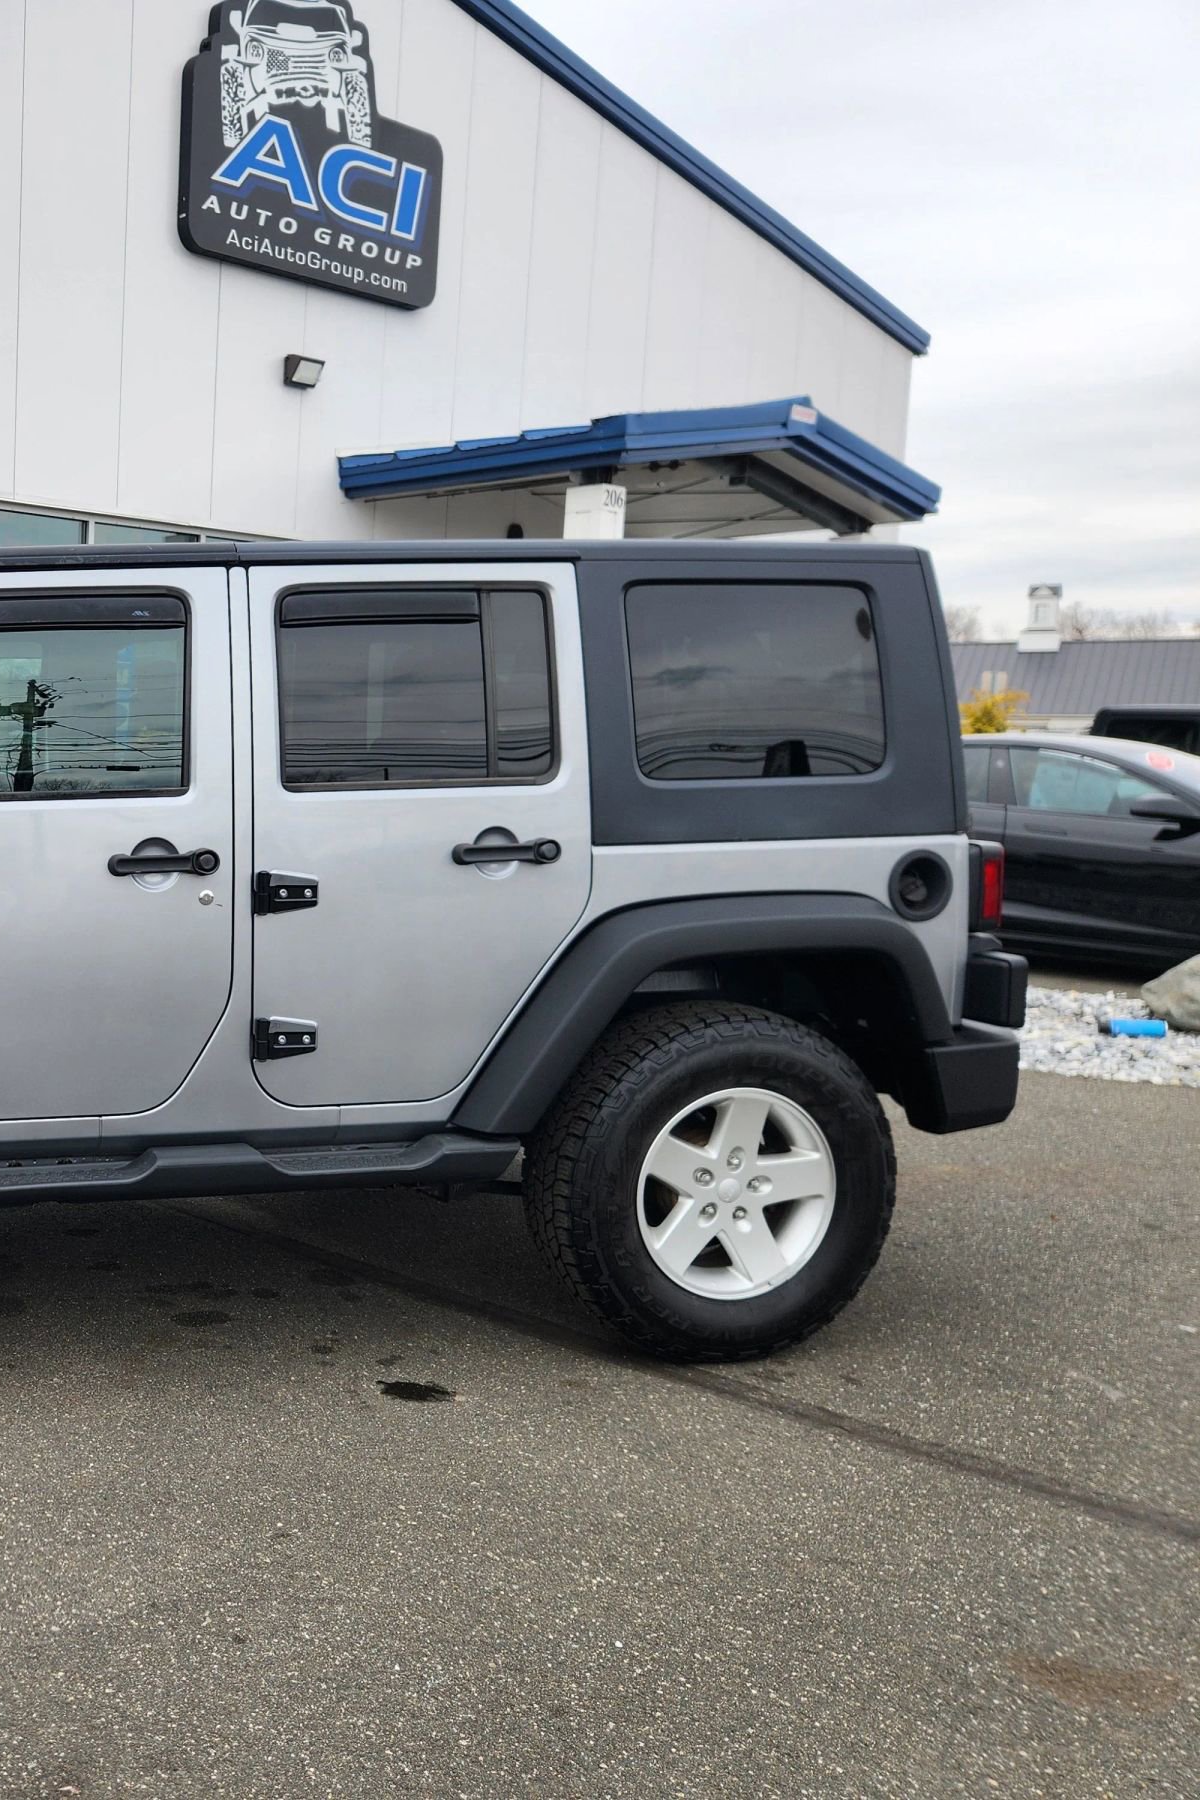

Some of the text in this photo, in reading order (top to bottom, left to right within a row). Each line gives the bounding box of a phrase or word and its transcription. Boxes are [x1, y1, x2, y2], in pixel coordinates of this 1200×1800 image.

[210, 113, 428, 241] ACI
[201, 195, 422, 270] AUTO GROUP
[225, 229, 408, 293] AciAutoGroup.com
[603, 488, 624, 508] 206
